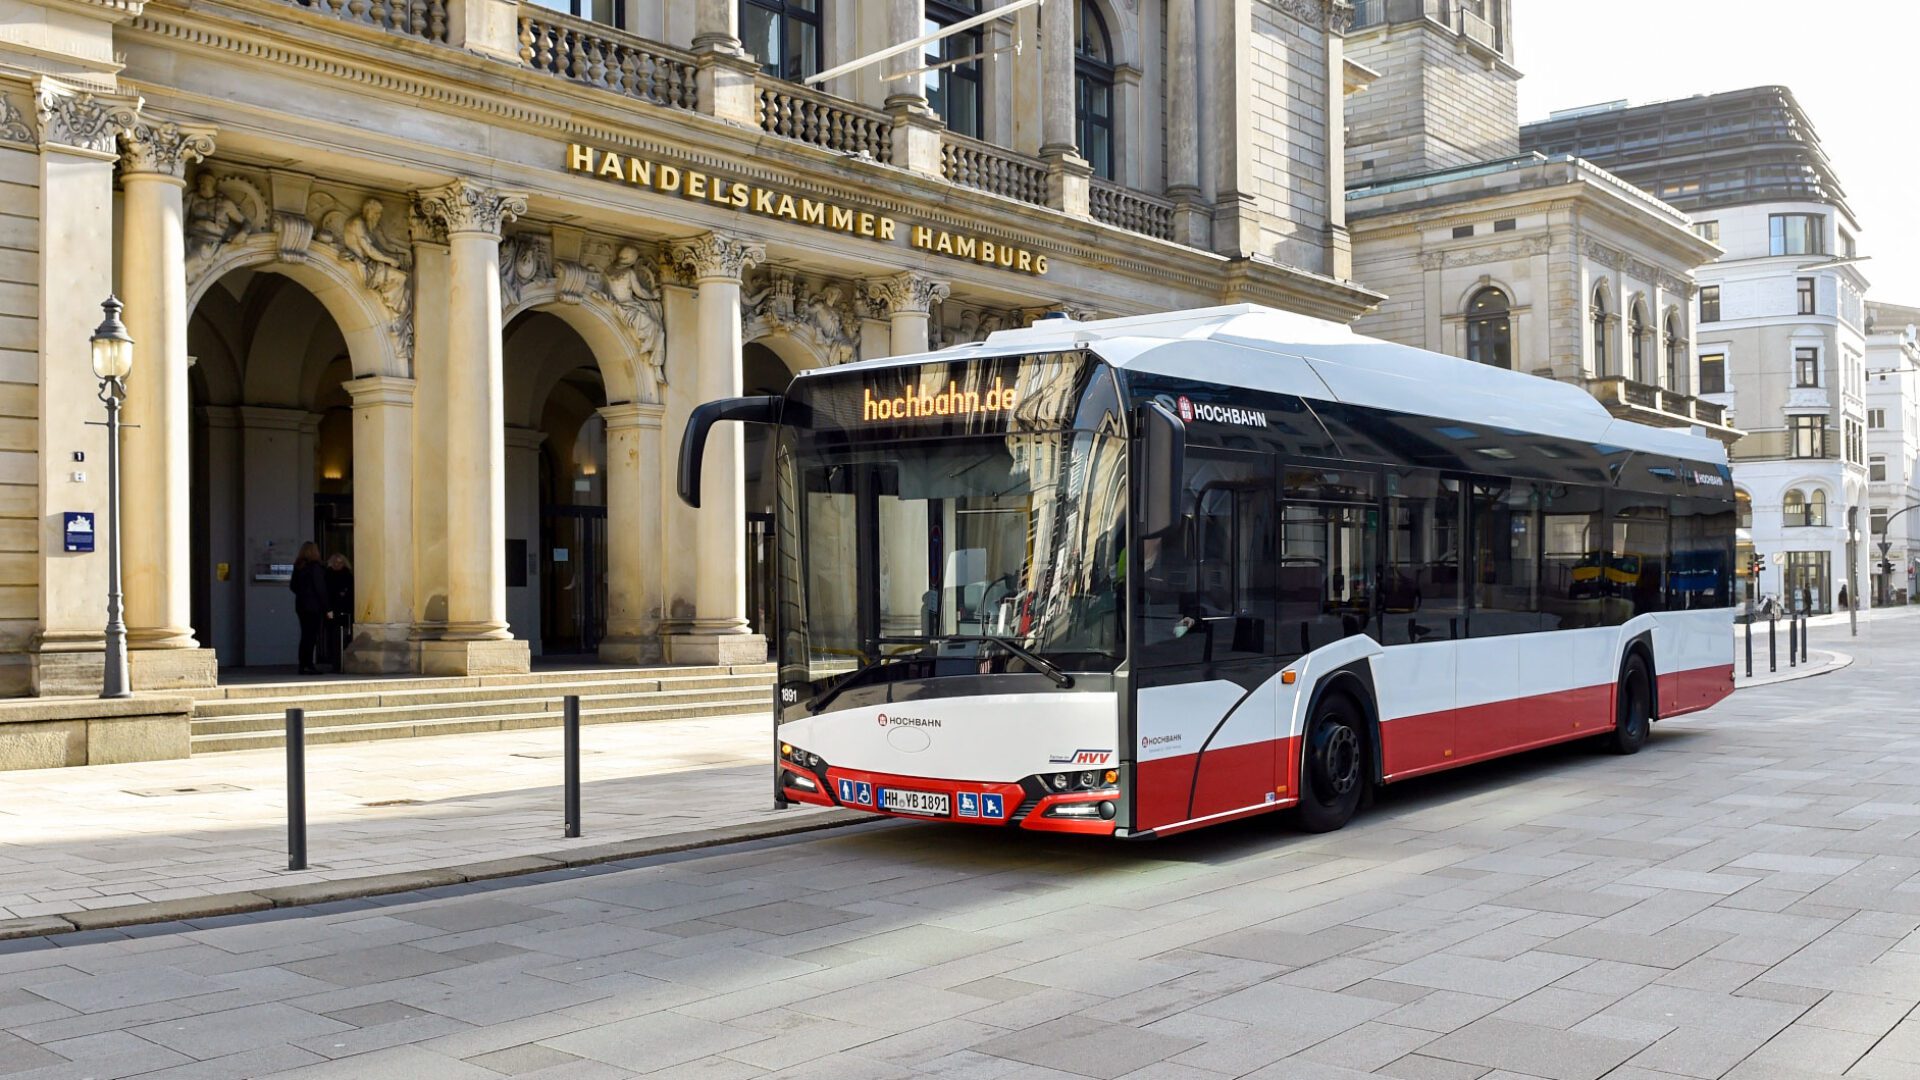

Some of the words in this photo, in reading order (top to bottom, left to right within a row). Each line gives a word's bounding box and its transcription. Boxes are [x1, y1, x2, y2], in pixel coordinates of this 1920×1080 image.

[567, 143, 896, 241] HANDELSKAMMER
[911, 225, 1049, 275] HAMBURG
[863, 376, 1018, 421] hochbahn.de
[1193, 402, 1268, 428] HOCHBAHN
[780, 687, 798, 702] 1891
[889, 717, 942, 728] HOCHBAHN
[1148, 733, 1182, 745] HOCHBAHN
[1077, 752, 1110, 764] HVV
[884, 790, 898, 806] HH
[905, 793, 919, 808] YB
[921, 795, 948, 812] 1891
